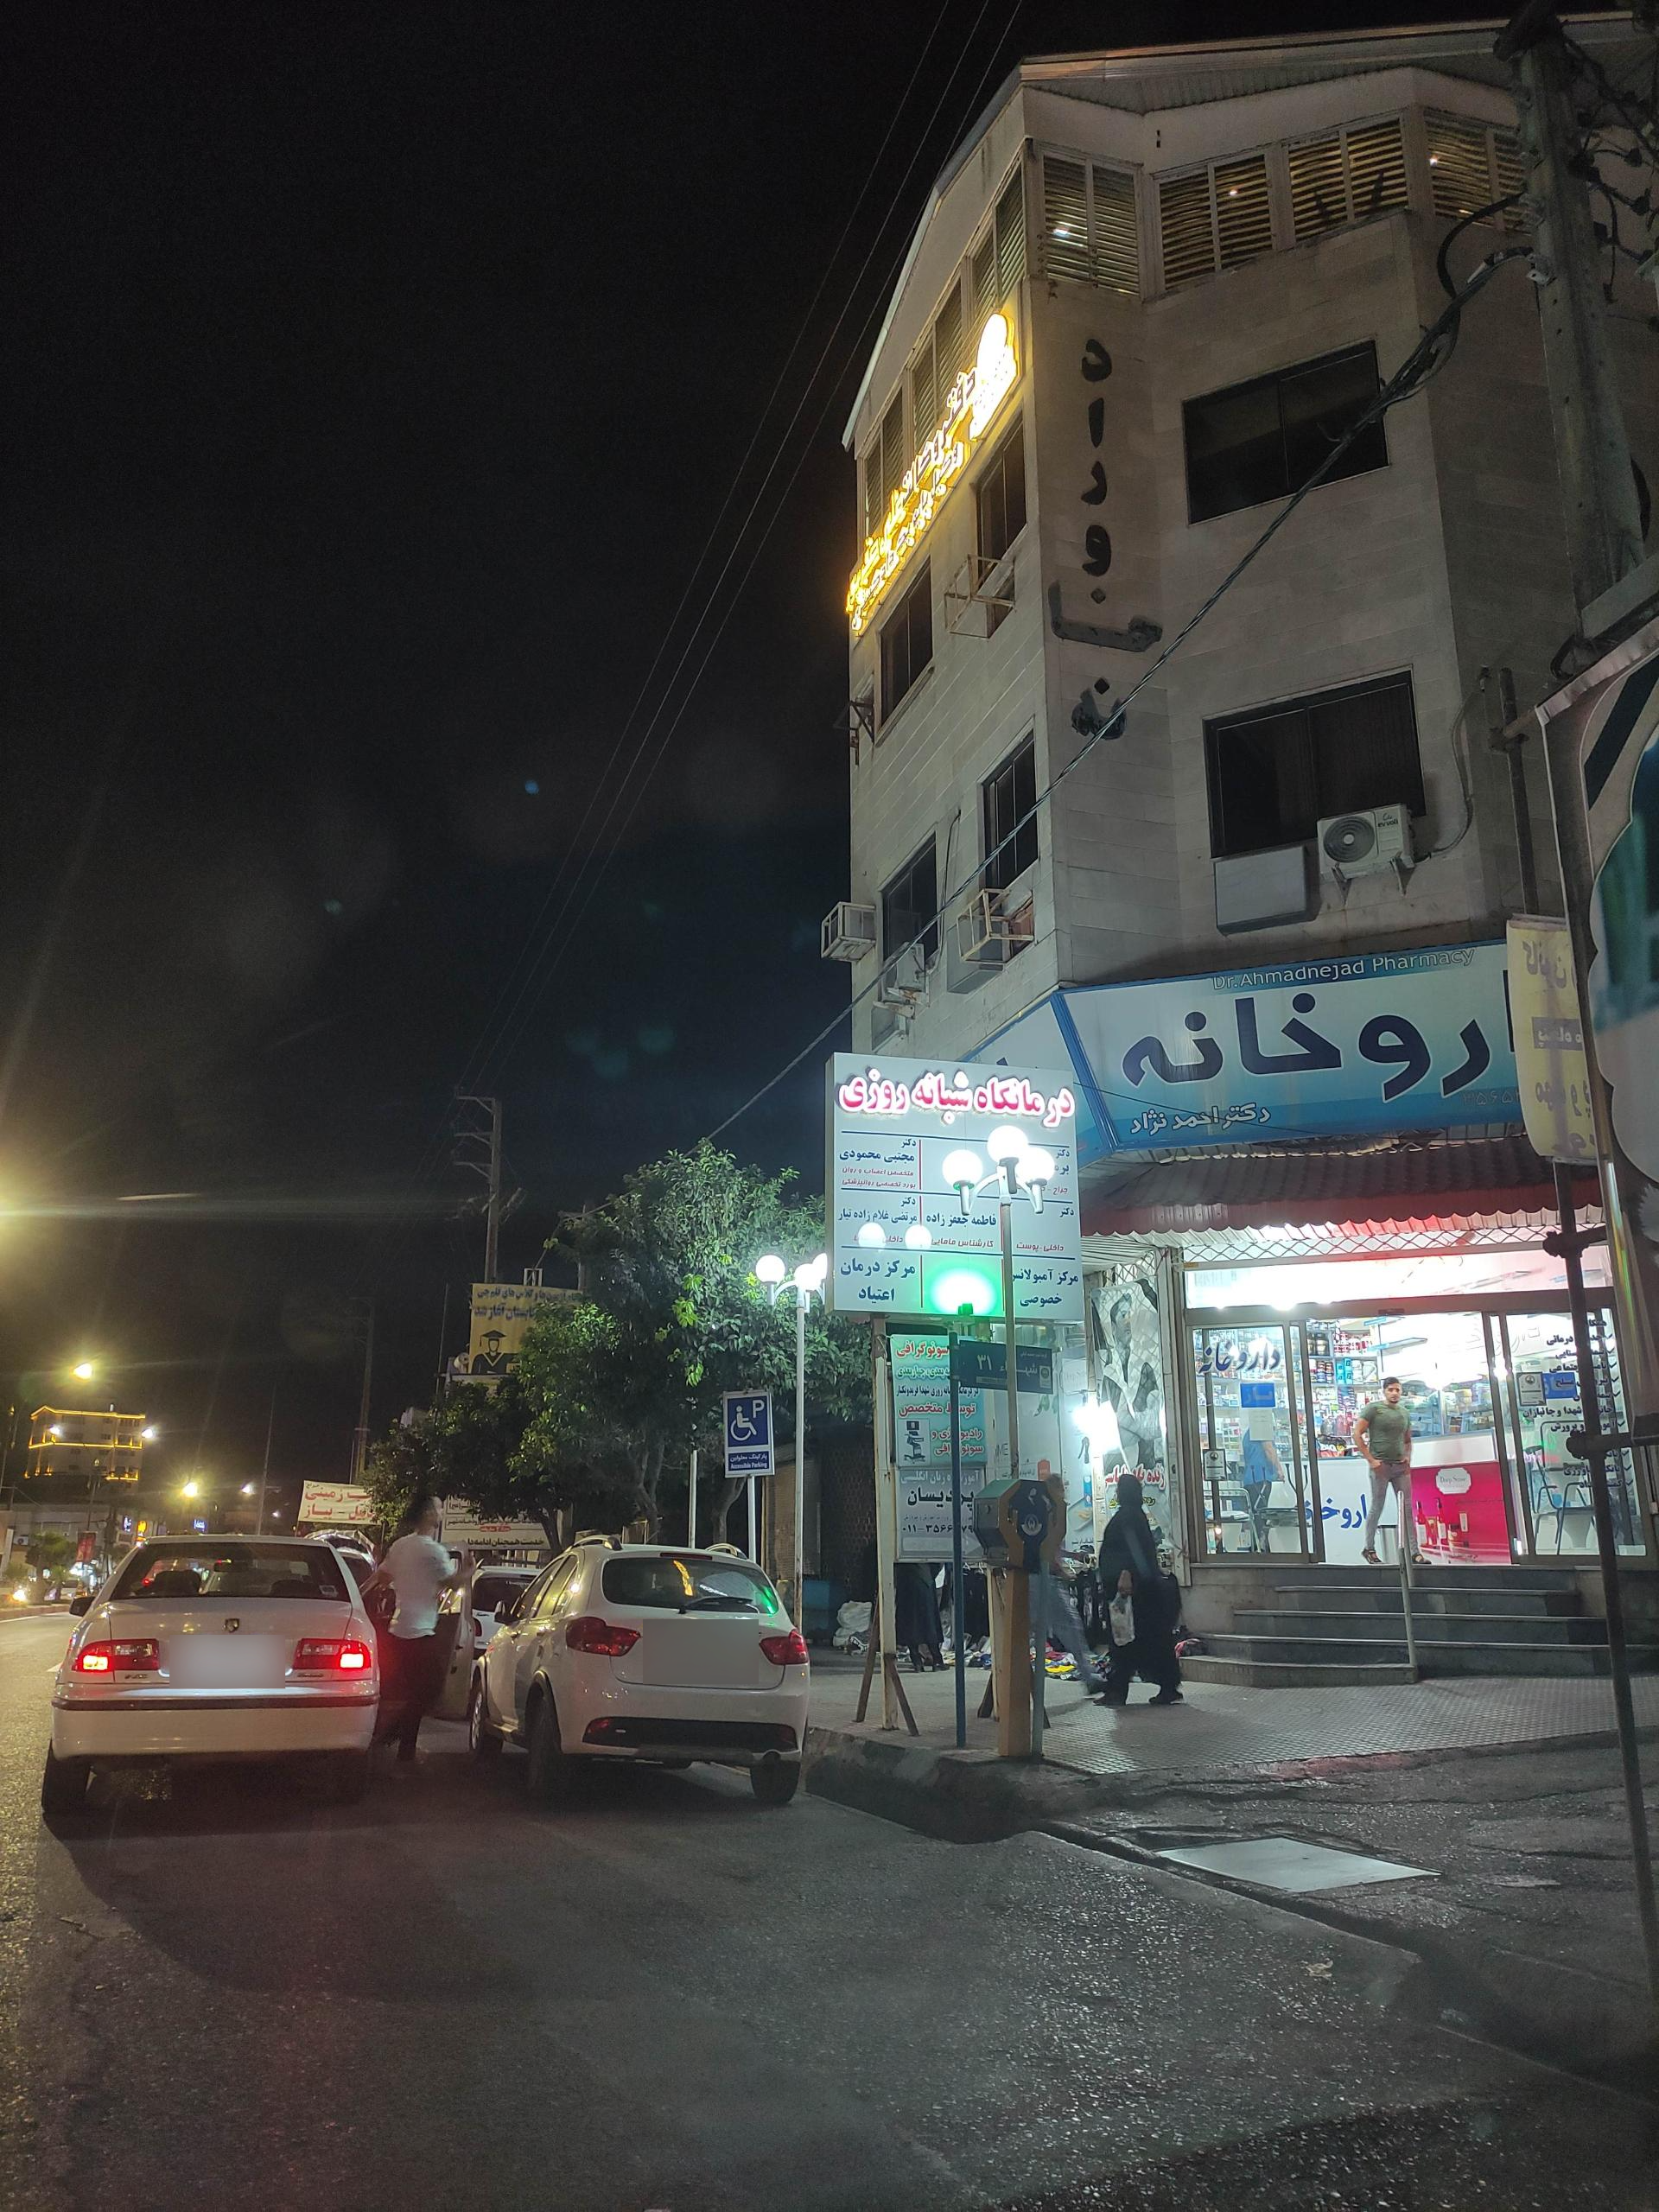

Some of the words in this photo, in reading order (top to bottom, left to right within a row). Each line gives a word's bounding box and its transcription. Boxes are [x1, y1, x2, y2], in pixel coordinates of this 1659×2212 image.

[1372, 947, 1476, 973] Pharmacy
[1122, 969, 1516, 1103] روخانه
[838, 1068, 908, 1116] روزی
[911, 1070, 973, 1125] شبانه
[1129, 1108, 1168, 1136] نژاد
[1171, 1105, 1219, 1131] احمد
[1222, 1102, 1272, 1130] دکتر
[901, 1138, 917, 1148] دکتر
[839, 1149, 881, 1161] محمودی
[884, 1152, 915, 1164] مجتبی
[1055, 1148, 1070, 1159] دکتر
[900, 1196, 916, 1207] دکتر
[891, 1211, 918, 1224] مرتضی
[926, 1212, 945, 1226] زاده
[971, 1213, 997, 1226] فاطمه
[1059, 1207, 1074, 1217] دکتر
[957, 1239, 995, 1248] کارشناس
[840, 1257, 880, 1277] درمان
[884, 1259, 916, 1279] مرکز
[1057, 1270, 1079, 1286] مرکز
[858, 1285, 895, 1304] اعتیاد
[1020, 1293, 1063, 1307] خصوصی
[896, 1340, 950, 1359] سونوگرافی
[1198, 1341, 1281, 1374] داروخانه
[976, 1354, 992, 1370] ۳۱
[753, 1400, 765, 1418] P
[899, 1401, 943, 1418] متخصص
[936, 1443, 983, 1456] سونوافی
